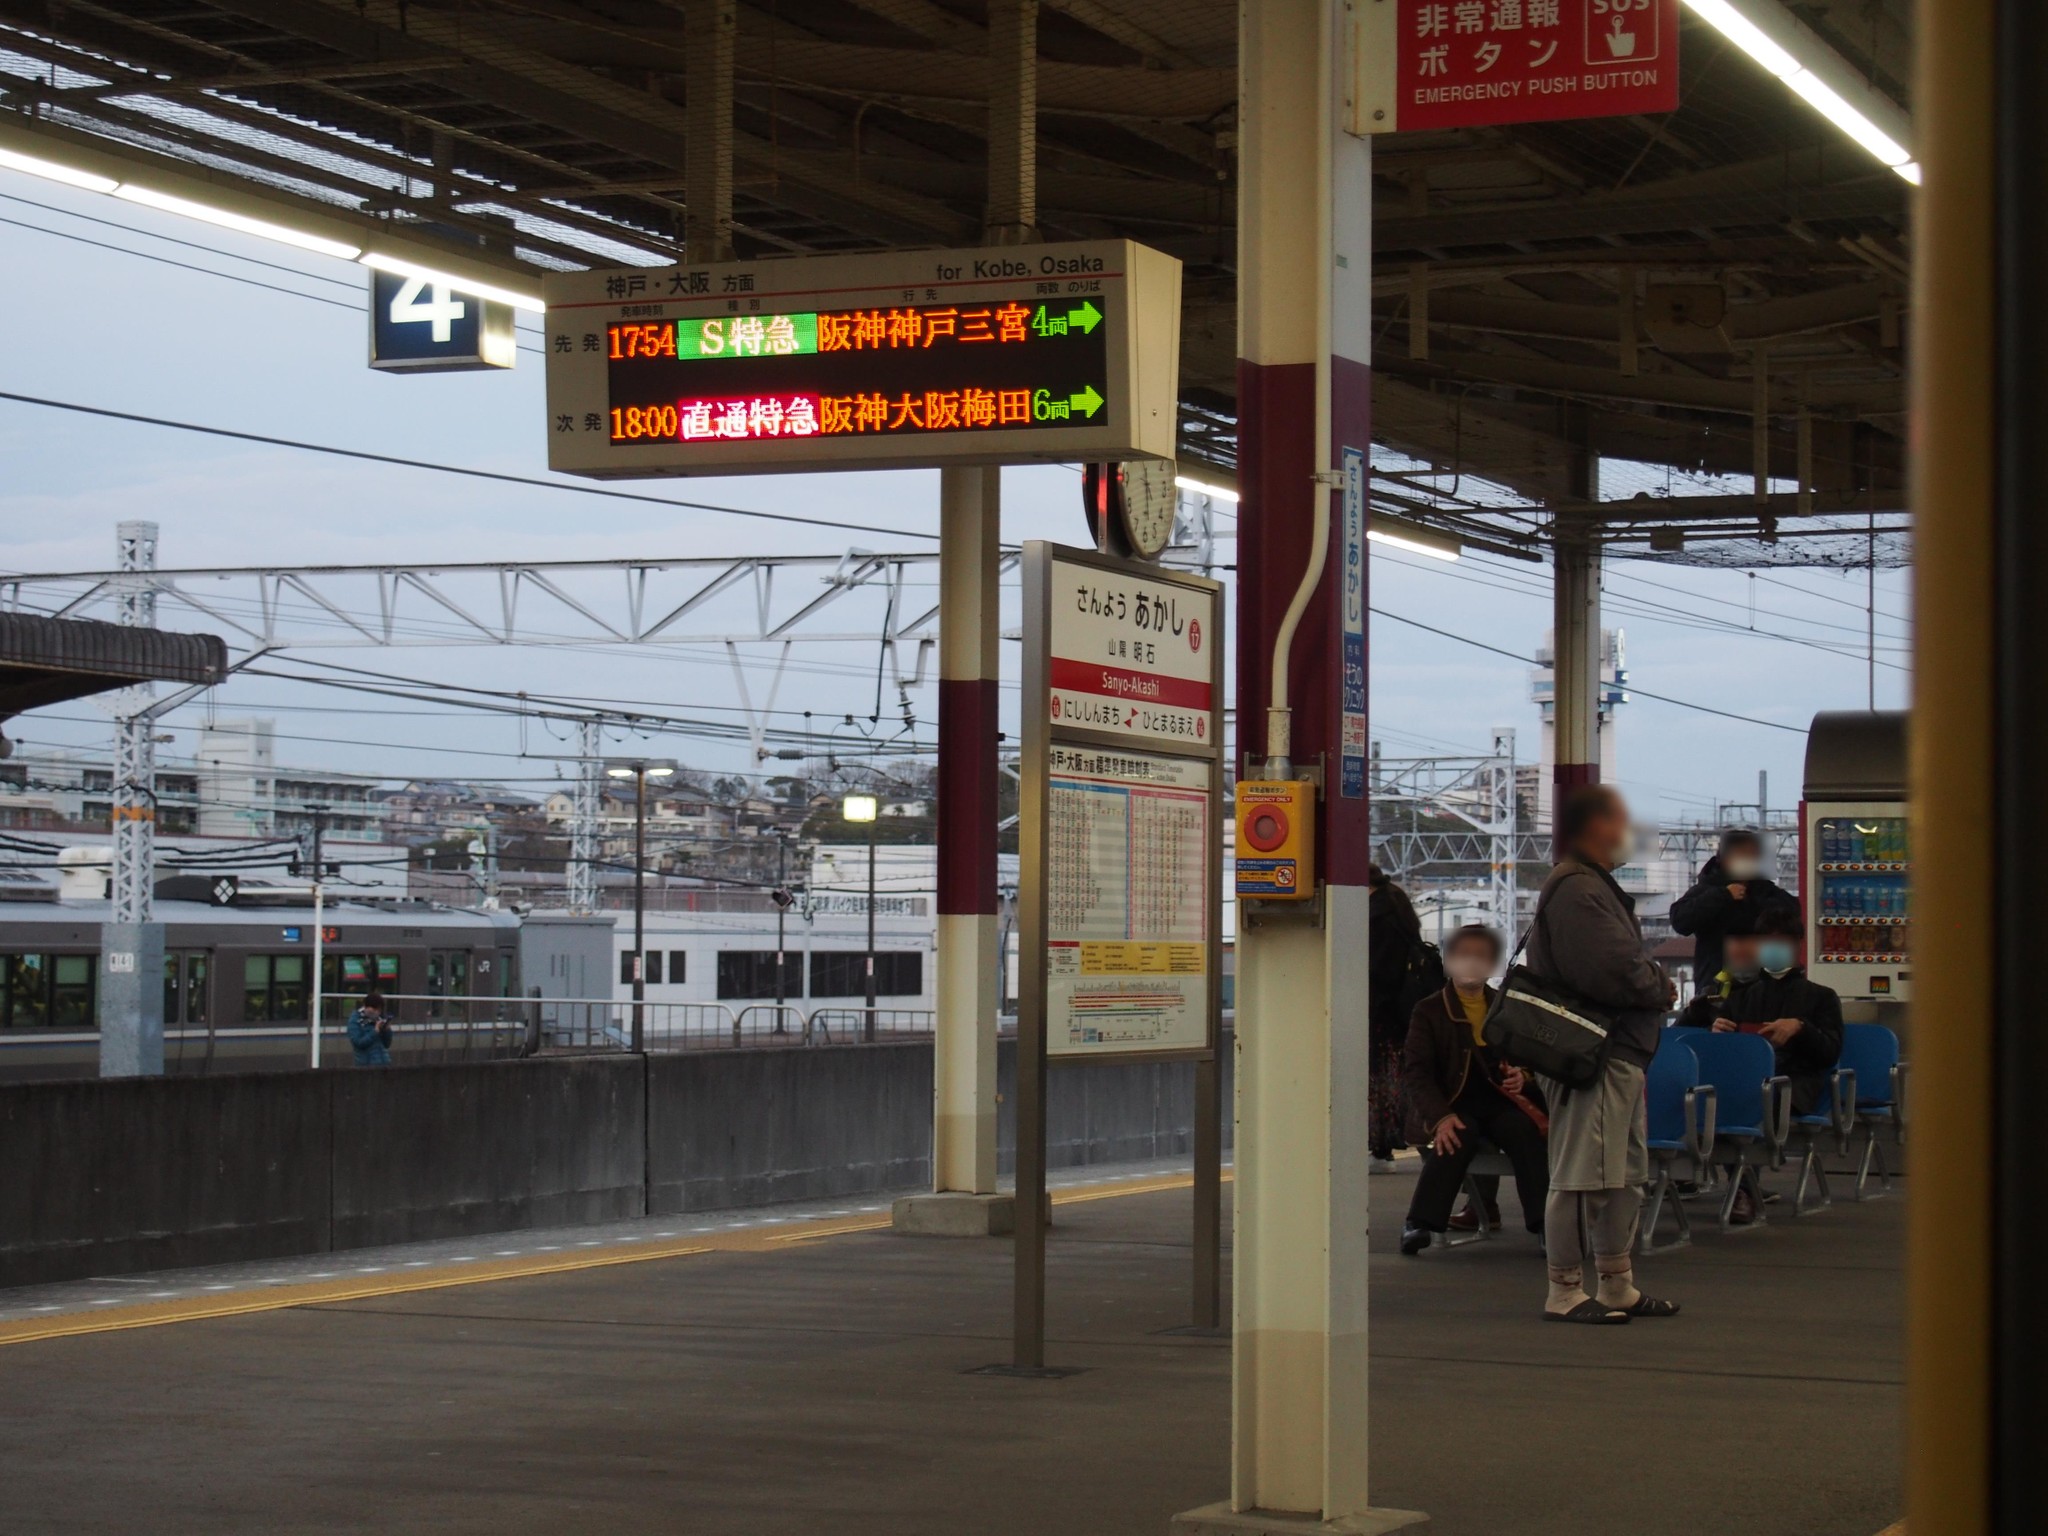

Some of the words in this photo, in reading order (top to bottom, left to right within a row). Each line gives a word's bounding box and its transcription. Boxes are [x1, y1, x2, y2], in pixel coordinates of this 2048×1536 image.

[1416, 0, 1561, 38] 非常通報
[1418, 40, 1559, 78] ボタン
[1415, 81, 1522, 105] EMERGENCY
[1529, 76, 1577, 95] PUSH
[1584, 70, 1658, 91] BUTTON
[606, 271, 711, 299] 神戸・大阪
[722, 273, 755, 293] 方面
[936, 264, 963, 281] for
[974, 258, 1032, 278] Kobe,
[1040, 254, 1104, 274] Osaka
[1036, 282, 1059, 295] 両数
[1067, 280, 1100, 293] のりば
[390, 275, 465, 342] 4
[608, 323, 677, 359] 17:54
[700, 314, 801, 356] S特急
[817, 302, 1031, 351] 阪神神戸三宮
[1031, 305, 1068, 337] 4両
[610, 405, 678, 439] 18:00
[681, 396, 819, 439] 直通特急
[820, 388, 1031, 433] 阪神大阪梅田
[1032, 388, 1070, 421] 6両
[1348, 542, 1360, 623] あかし
[1077, 585, 1127, 620] さんよう
[1135, 591, 1183, 636] あかし
[1134, 641, 1155, 665] 明石
[1191, 633, 1200, 647] 17
[1102, 671, 1160, 697] Sanyo-Akashi
[1064, 699, 1120, 726] にししんまち
[1143, 711, 1194, 737] ひとまるまえ
[478, 960, 491, 973] JR
